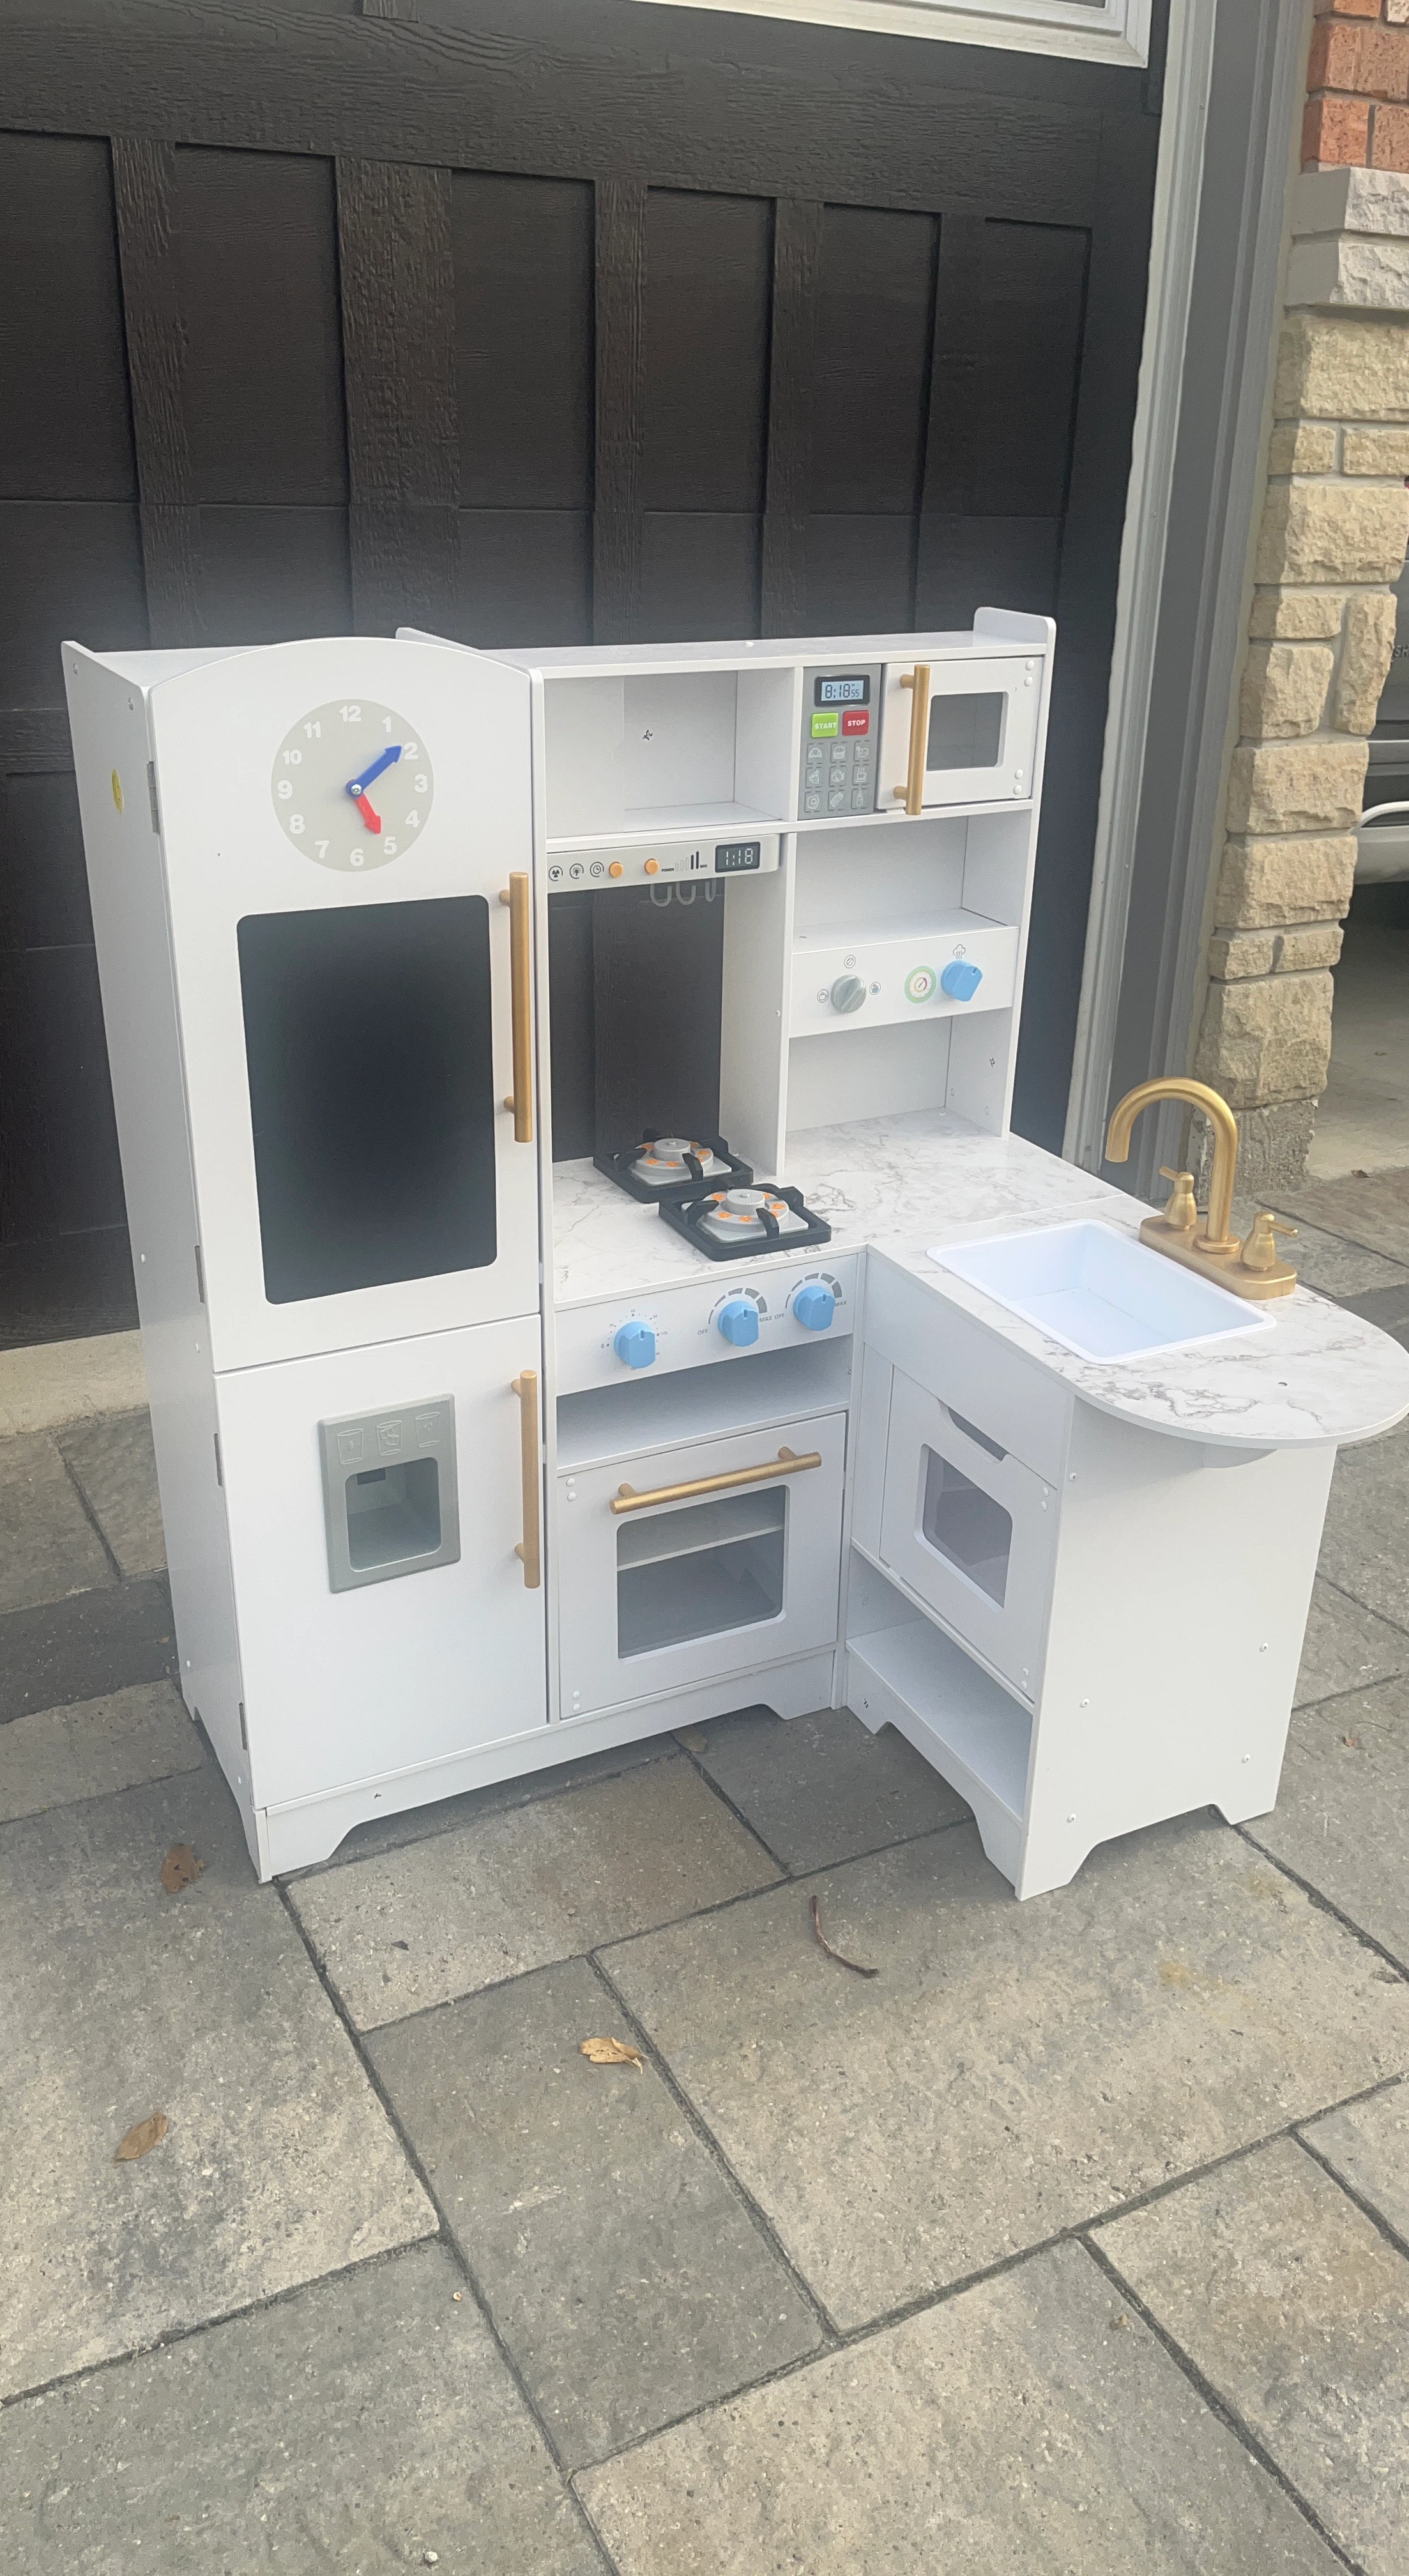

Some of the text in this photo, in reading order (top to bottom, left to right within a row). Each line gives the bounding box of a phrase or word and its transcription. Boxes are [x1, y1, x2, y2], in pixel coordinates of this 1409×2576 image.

[339, 705, 362, 722] 12
[303, 721, 321, 739] 11
[383, 716, 392, 733] 1
[282, 749, 302, 765] 10
[404, 742, 419, 760] 2
[277, 779, 293, 800] 9
[415, 774, 429, 793] 3
[289, 814, 306, 834] 8
[405, 809, 420, 828] 4
[315, 840, 330, 859] 7
[383, 836, 397, 855] 5
[349, 848, 365, 867] 6
[726, 848, 754, 866] 1:18
[759, 1315, 773, 1323] MAX
